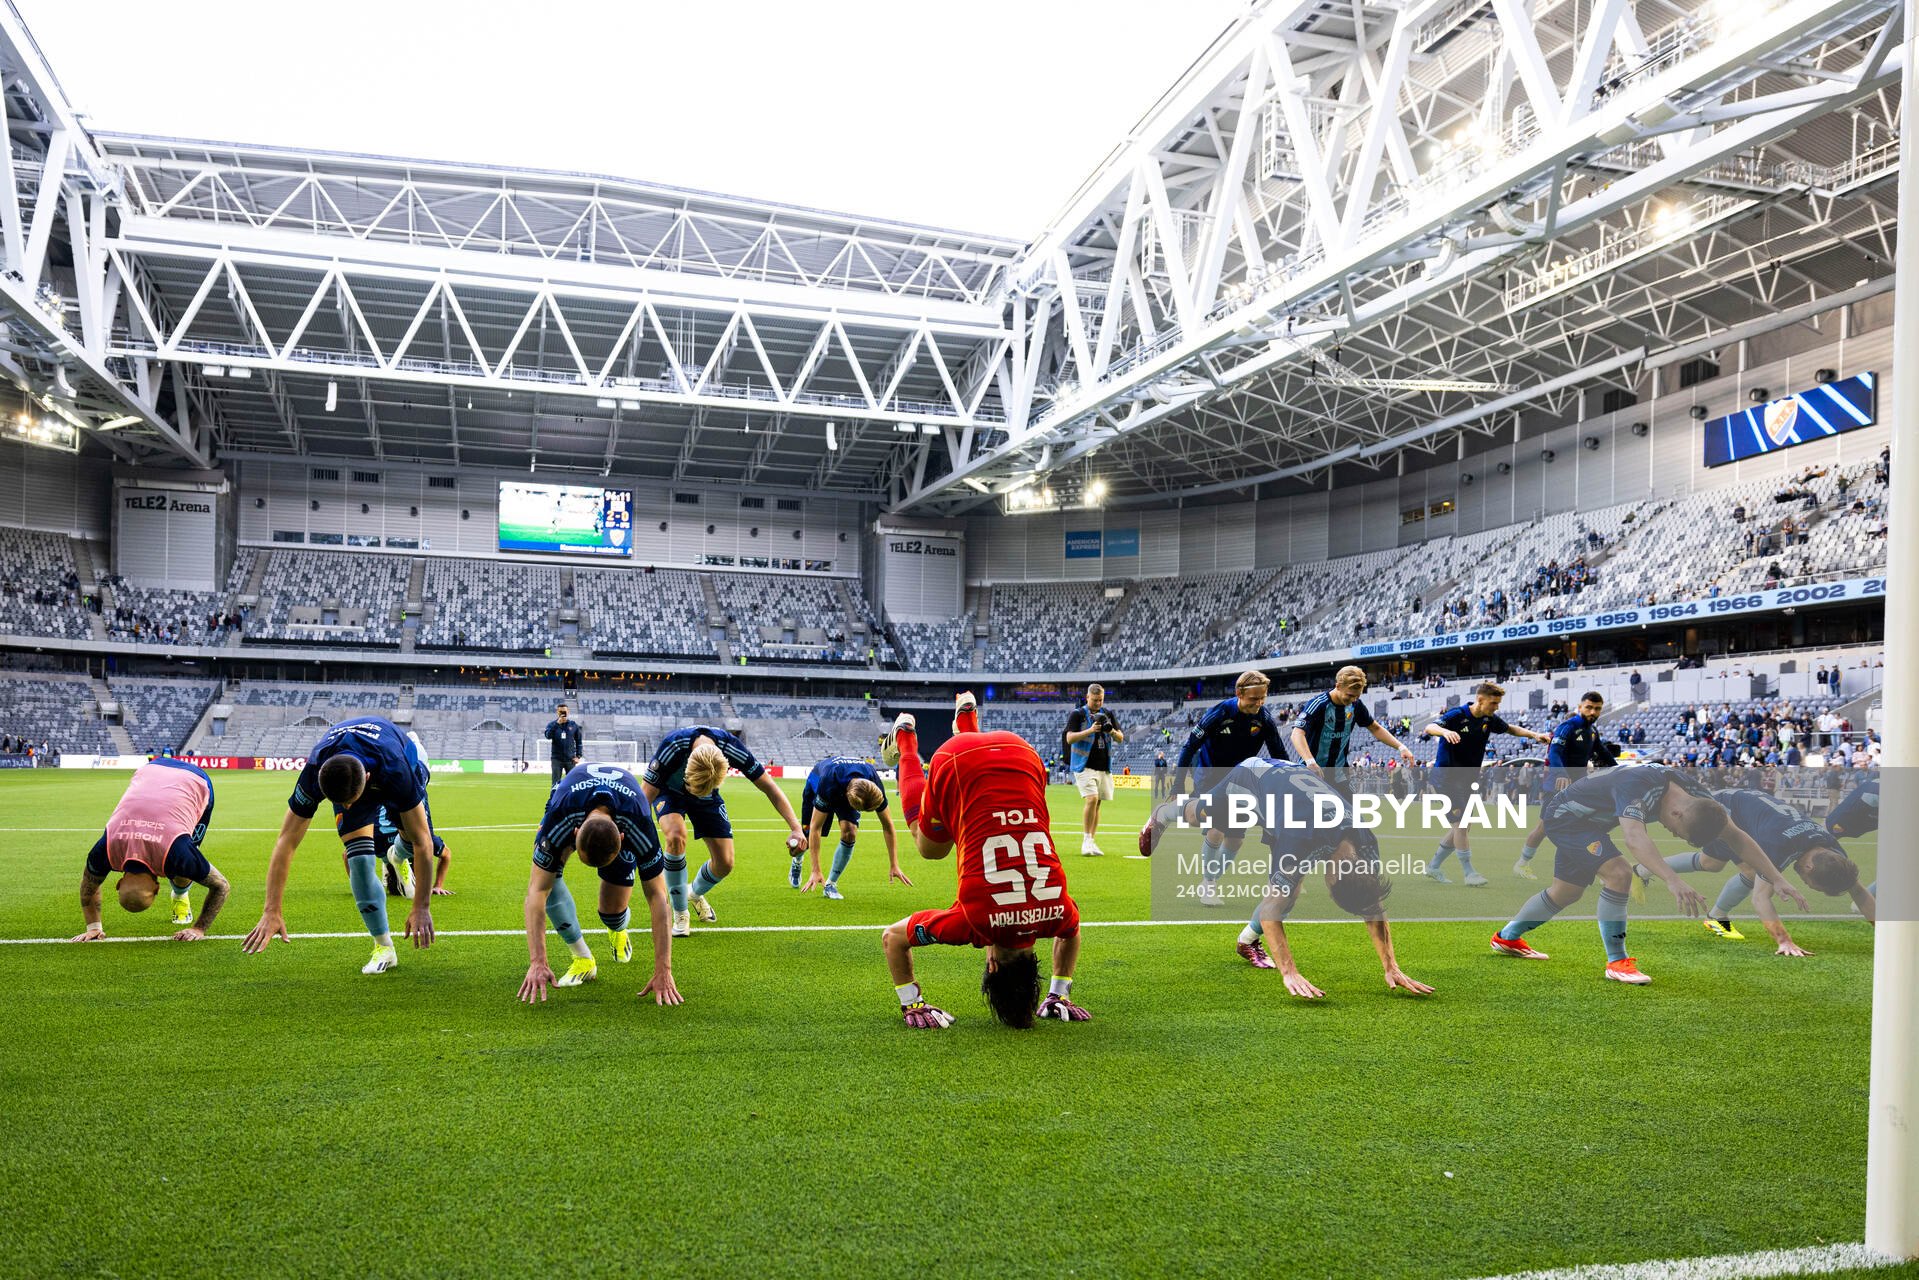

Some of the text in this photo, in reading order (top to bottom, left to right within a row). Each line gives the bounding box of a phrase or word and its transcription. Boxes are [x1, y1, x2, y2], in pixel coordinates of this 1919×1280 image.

[125, 495, 210, 513] TELE2 Arena
[890, 541, 956, 556] TELE2 Arena
[1399, 640, 1425, 651] 1912
[1431, 635, 1458, 647] 1915
[1465, 630, 1495, 643] 1917
[1502, 624, 1540, 638] 1920
[1547, 618, 1587, 633] 1955
[1595, 612, 1639, 627] 1959
[1649, 603, 1698, 620] 1964
[1708, 595, 1763, 613] 1966
[1776, 584, 1846, 604] 2002
[570, 777, 637, 798] JOHANSSON
[992, 809, 1039, 826] TCL
[114, 832, 164, 843] MOBILL
[982, 832, 1062, 906] 35
[988, 905, 1065, 928] ZETTERSTRÖM
